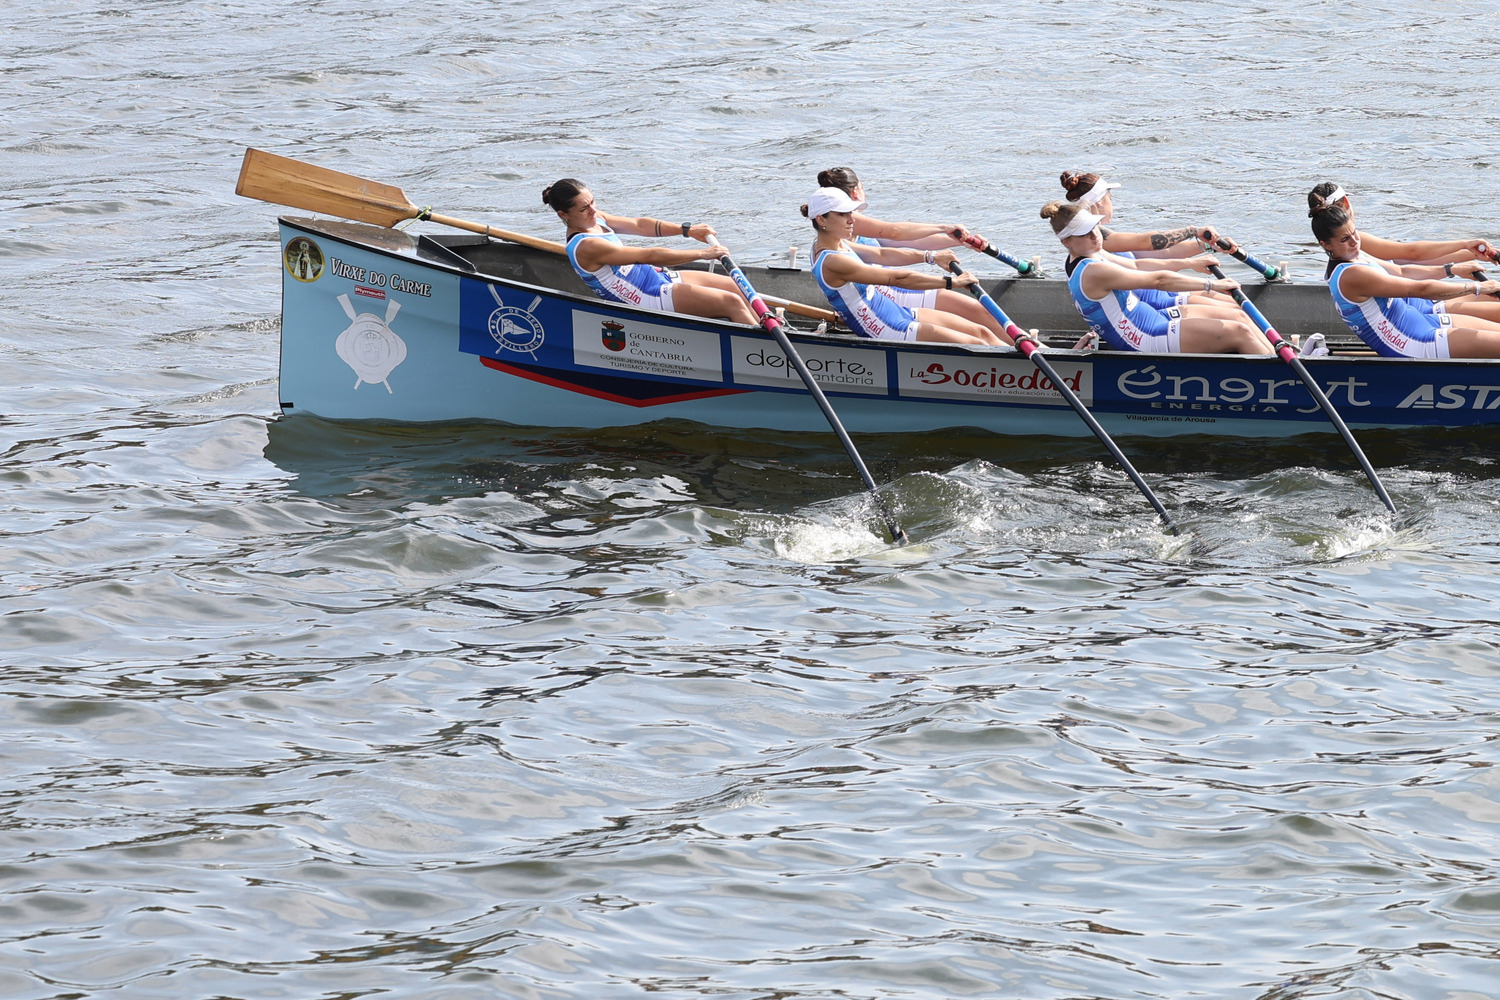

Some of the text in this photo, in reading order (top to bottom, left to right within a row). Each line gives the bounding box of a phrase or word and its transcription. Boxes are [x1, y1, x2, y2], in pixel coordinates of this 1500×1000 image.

[330, 257, 366, 280] VIRXE
[390, 276, 431, 297] CARME
[493, 333, 539, 351] ASTILLERO
[629, 332, 685, 346] GOBIERNO
[630, 348, 693, 363] CANTABRIA
[610, 361, 644, 371] TURISMO
[651, 367, 687, 376] DEPORTE
[812, 372, 874, 386] antabria
[921, 363, 1082, 392] Sociedad
[1126, 414, 1216, 424] Vilagarcía de Arousa
